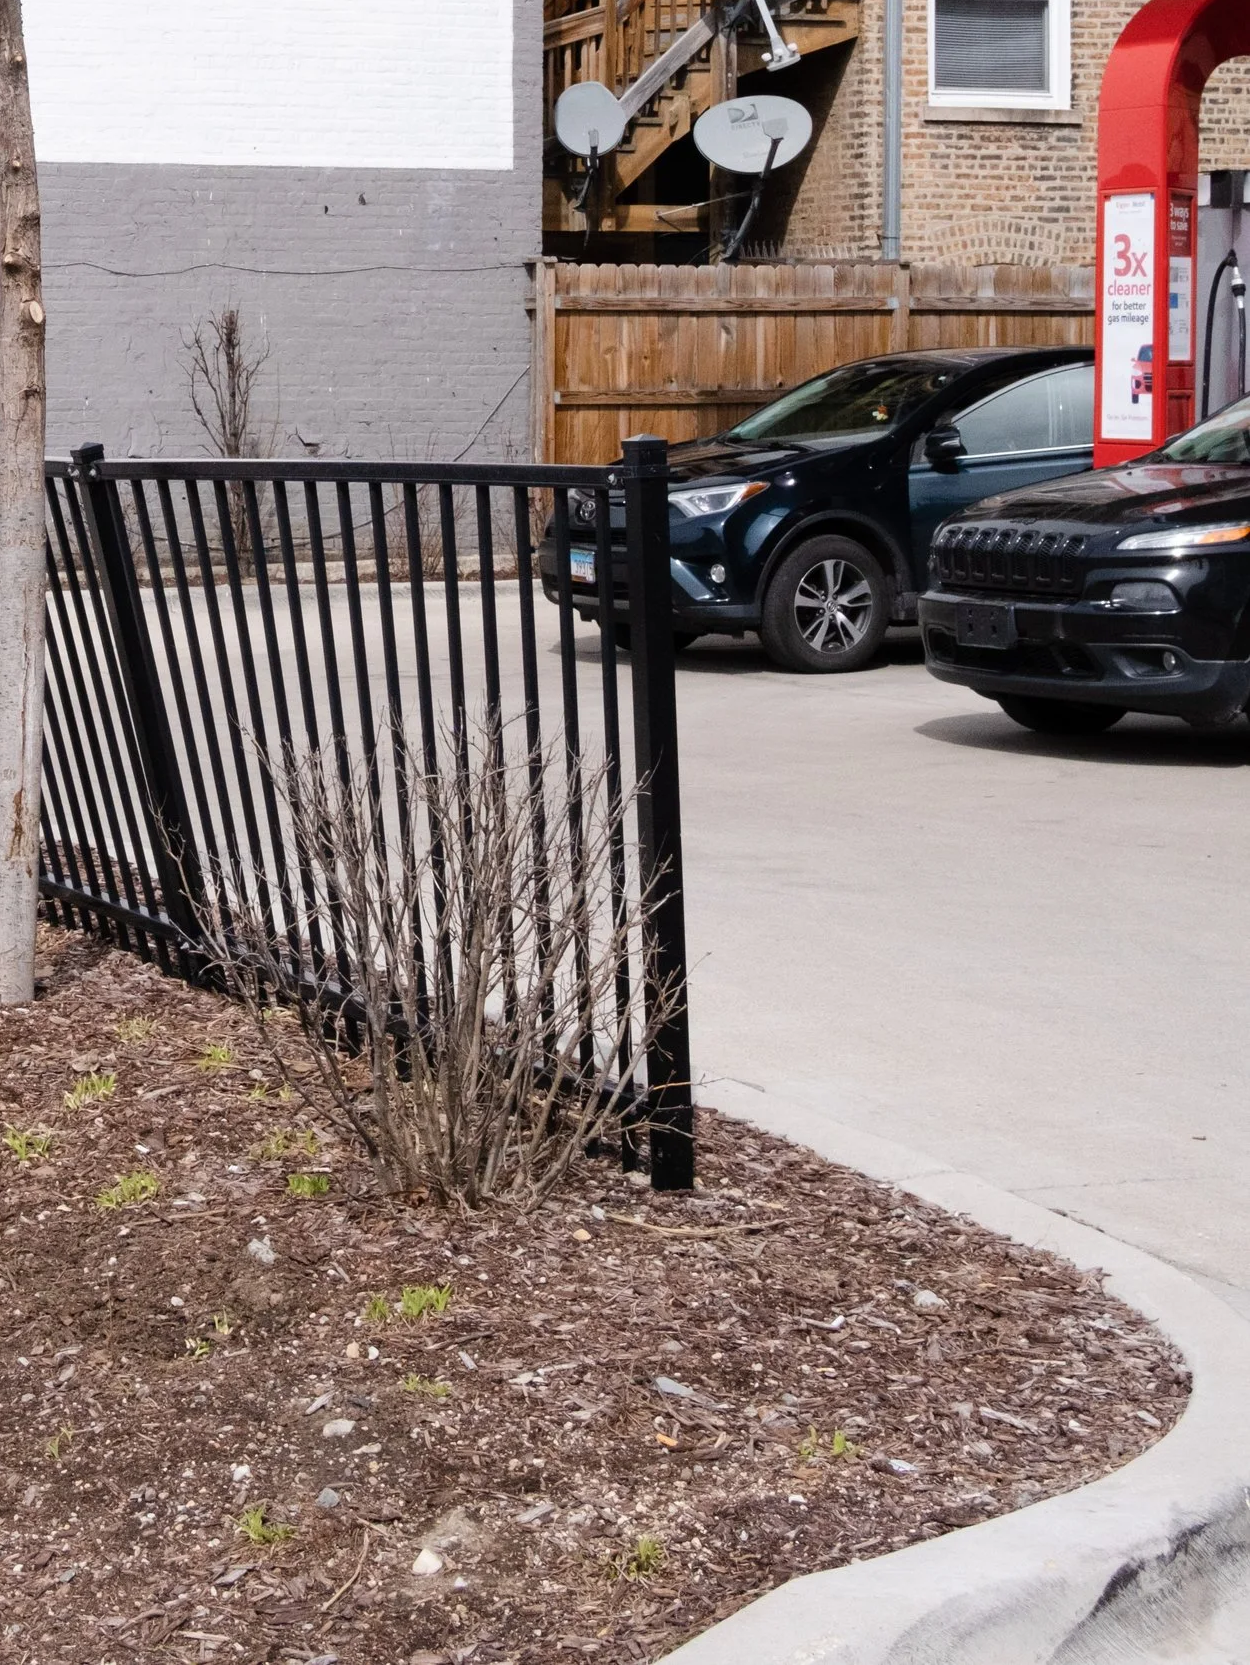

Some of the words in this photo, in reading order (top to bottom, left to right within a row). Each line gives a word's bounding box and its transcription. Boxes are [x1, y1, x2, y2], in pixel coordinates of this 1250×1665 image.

[1114, 233, 1148, 278] 3x
[1107, 279, 1152, 296] cleaner
[1112, 301, 1123, 311] for
[1123, 300, 1147, 311] better
[1107, 313, 1120, 326] gas
